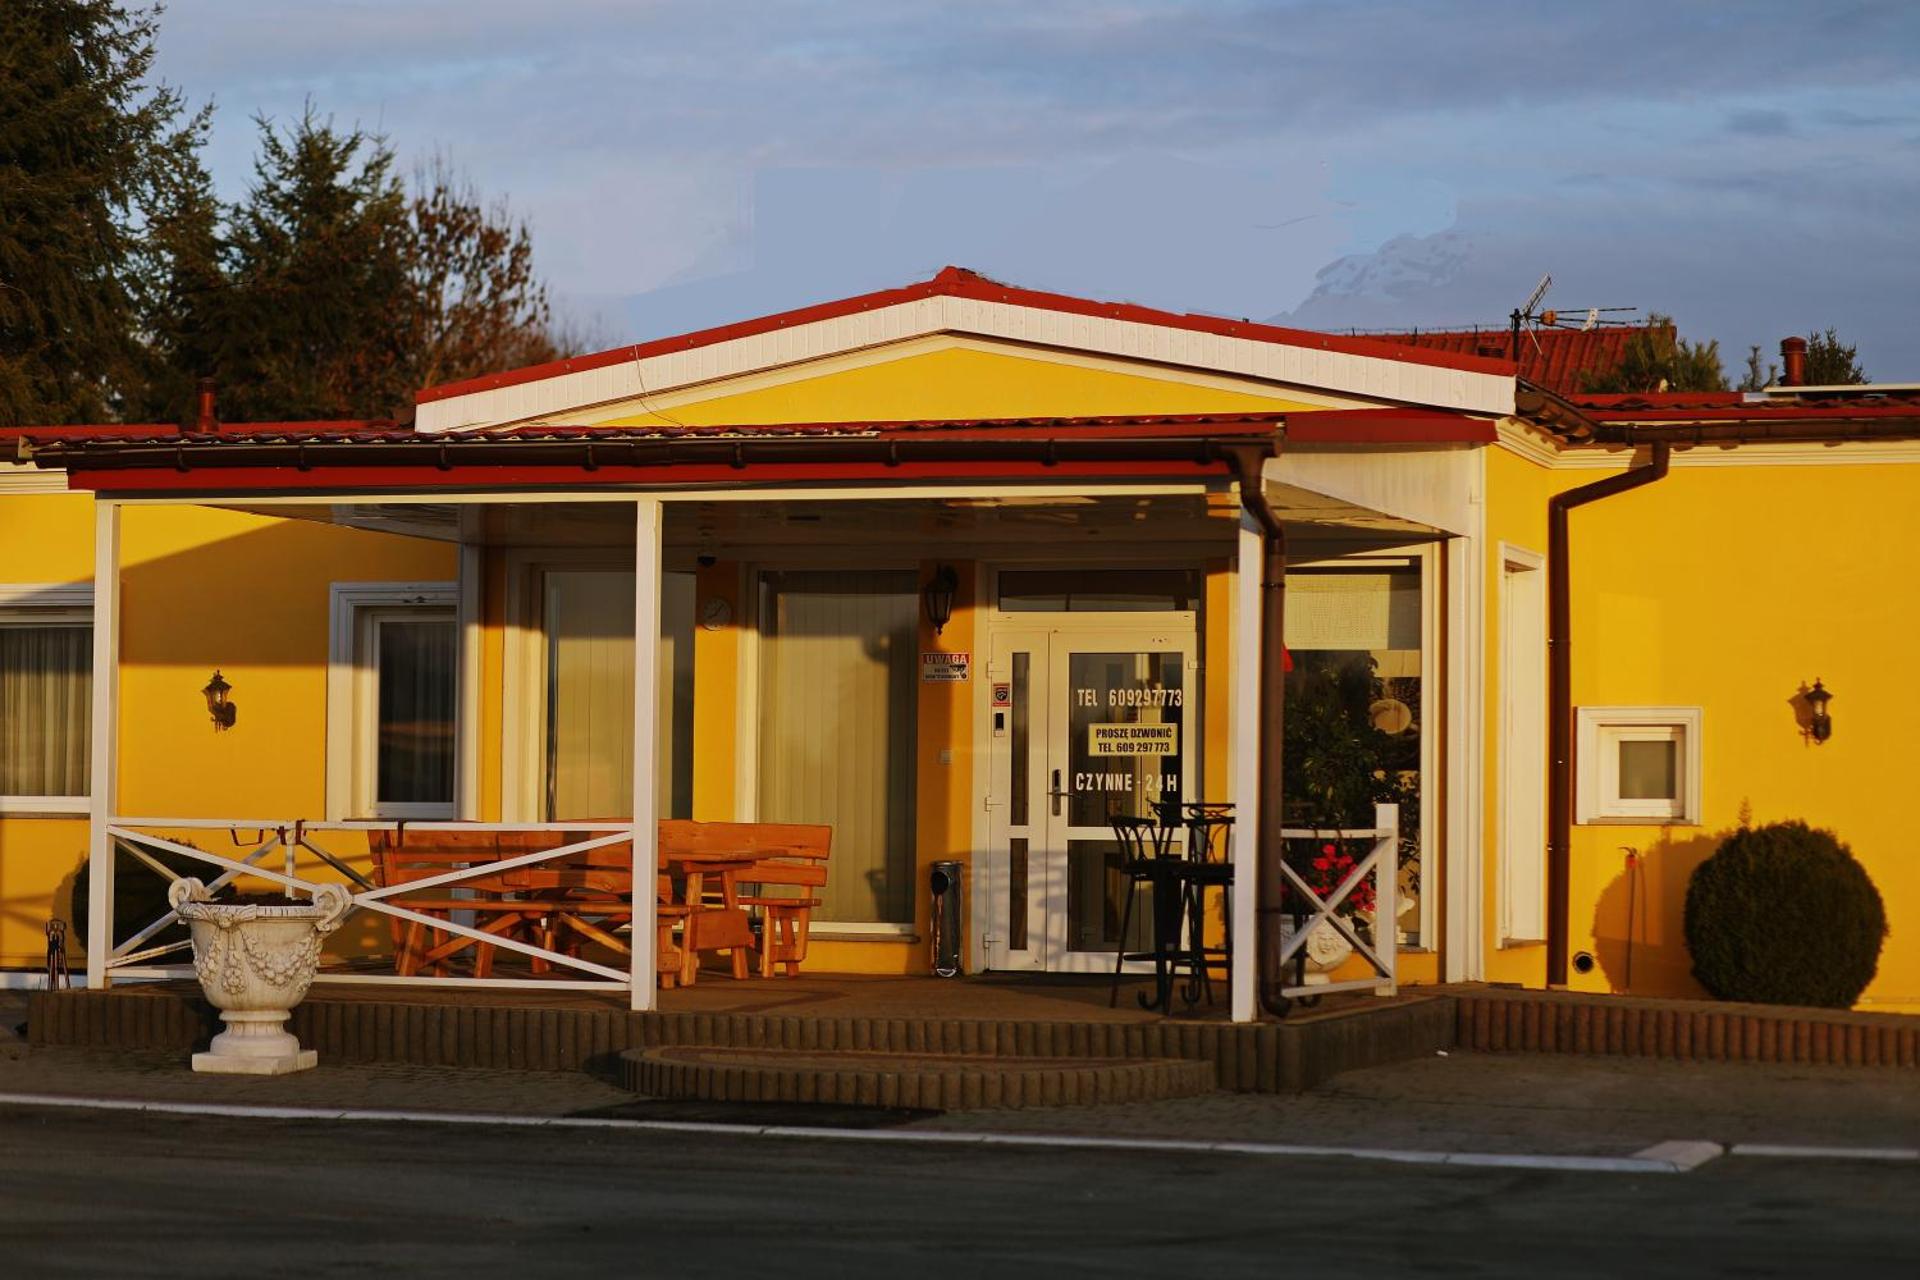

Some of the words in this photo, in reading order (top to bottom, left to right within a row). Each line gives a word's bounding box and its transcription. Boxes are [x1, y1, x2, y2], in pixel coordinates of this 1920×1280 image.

[926, 654, 967, 664] UWAGA
[1077, 689, 1098, 706] TEL
[1109, 689, 1182, 706] 609297773
[1096, 728, 1129, 740] PROSZĘ
[1130, 727, 1172, 738] DZWONIĆ
[1116, 742, 1135, 752] 609
[1155, 742, 1170, 752] 773
[1076, 773, 1132, 791] CZYNNE
